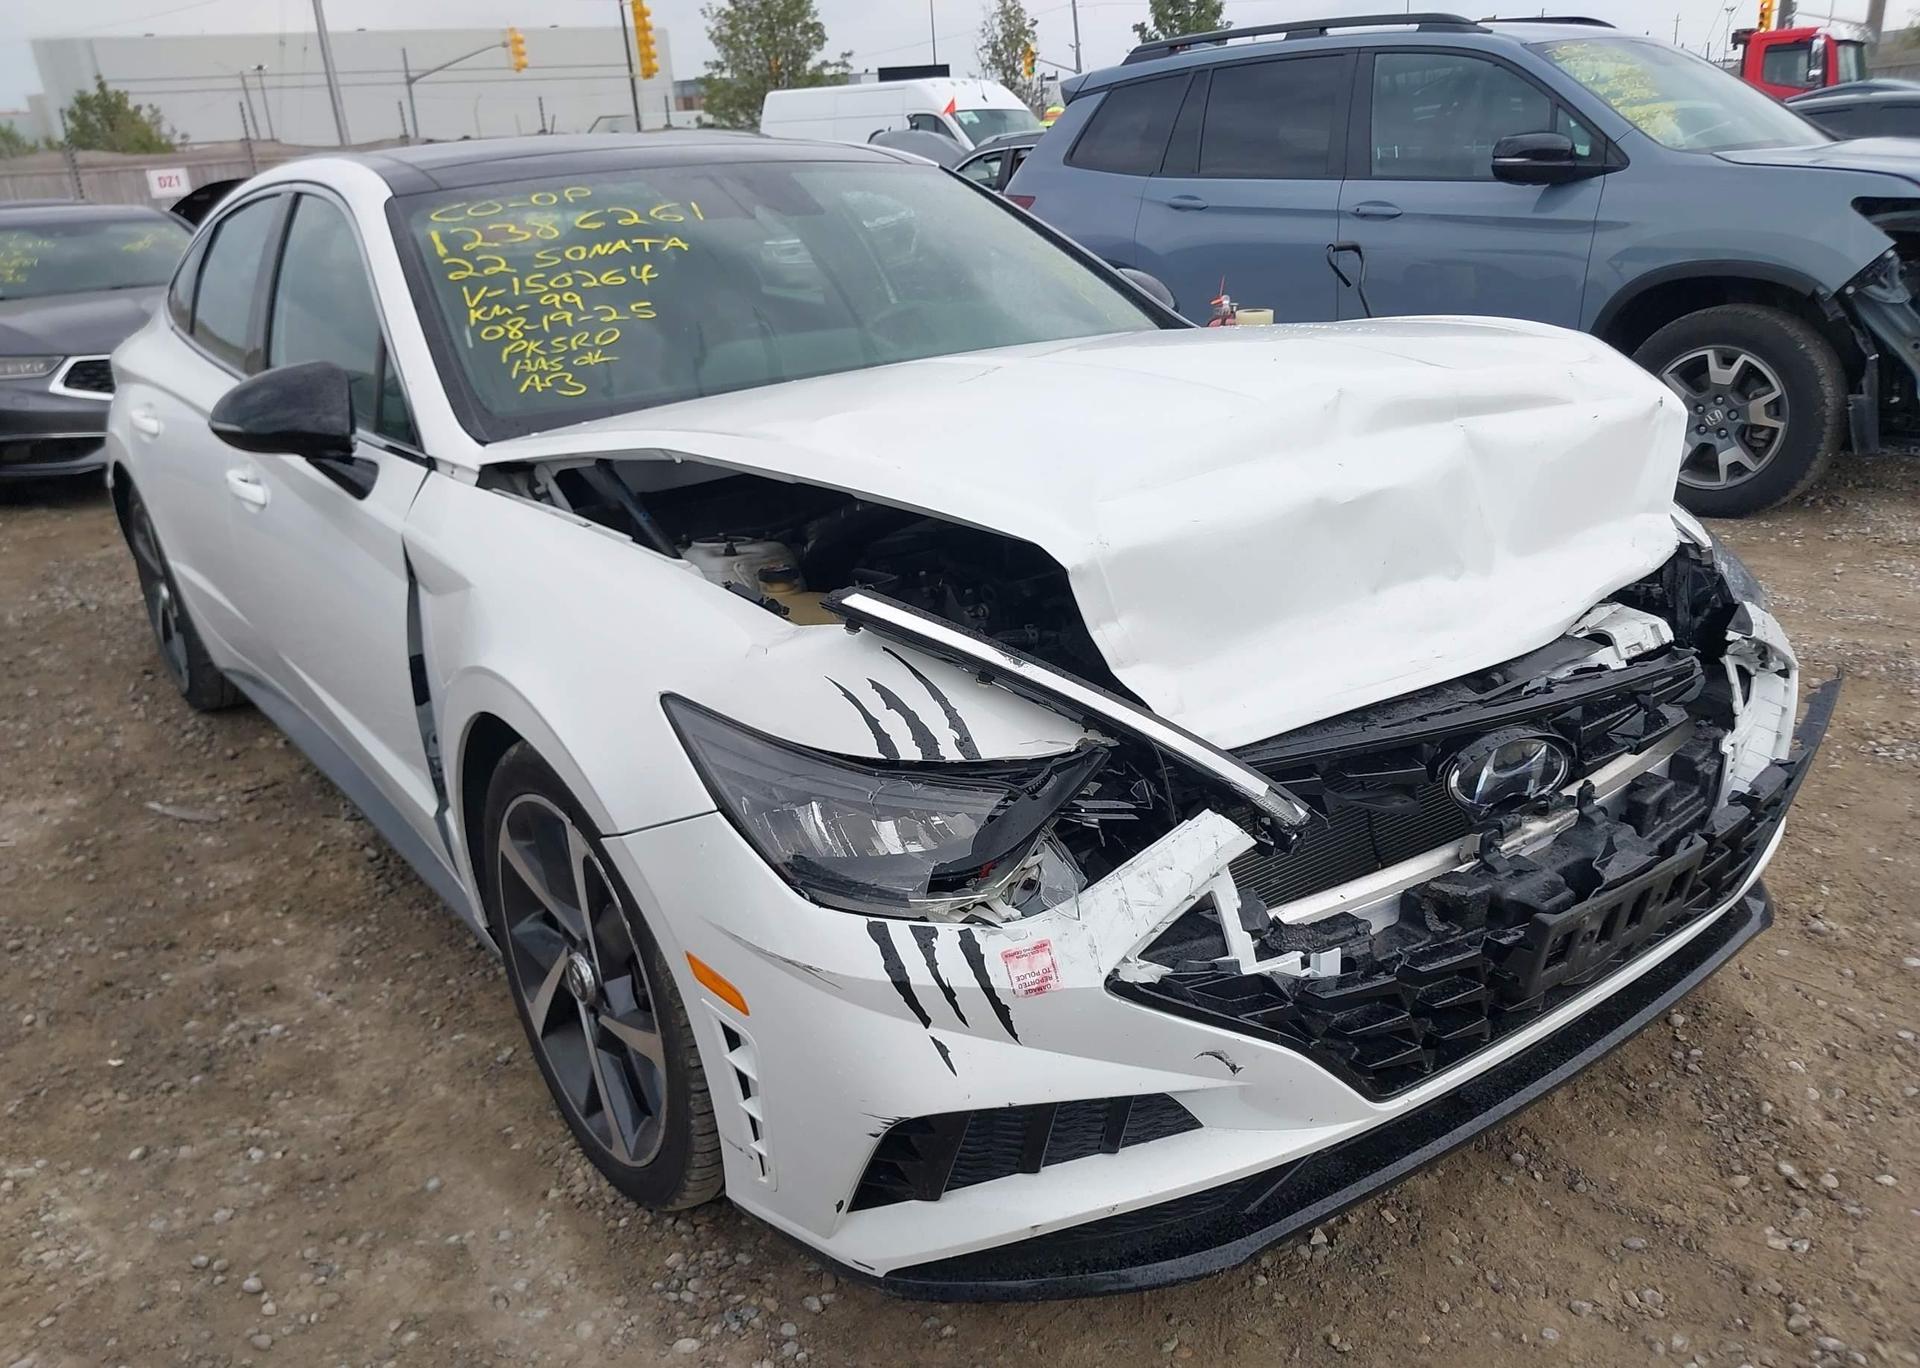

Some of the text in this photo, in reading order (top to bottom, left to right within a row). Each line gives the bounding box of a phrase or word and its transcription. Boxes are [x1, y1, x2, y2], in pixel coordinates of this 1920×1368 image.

[443, 236, 690, 281] 22 SONATA
[1015, 967, 1052, 982] TO POLICE
[1018, 975, 1053, 990] REPORTED
[1024, 983, 1052, 995] DAMAGE
